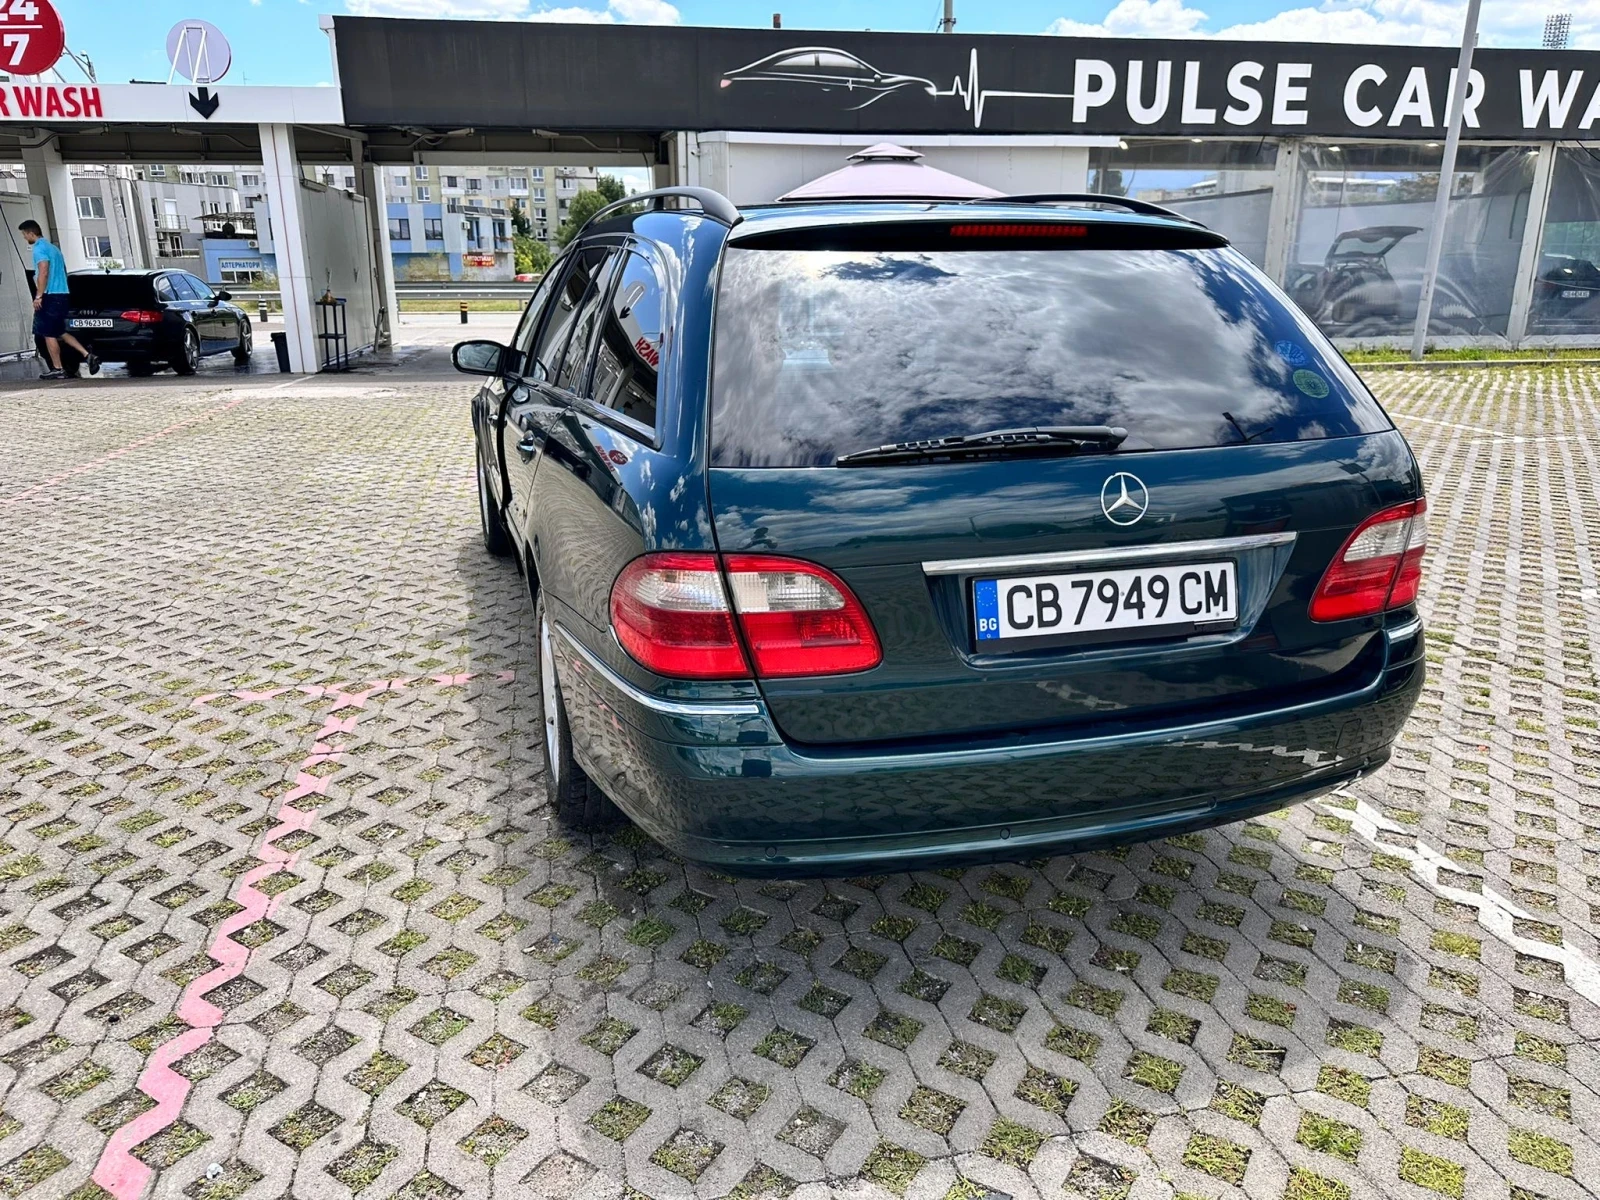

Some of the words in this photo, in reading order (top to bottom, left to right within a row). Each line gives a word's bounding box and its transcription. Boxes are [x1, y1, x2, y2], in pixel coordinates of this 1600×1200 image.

[3, 34, 30, 66] 7
[12, 86, 103, 118] WASH
[1072, 59, 1312, 125] PULSE
[1343, 63, 1486, 128] CAR
[1006, 582, 1063, 630] CB
[1071, 574, 1169, 625] 7949
[1179, 569, 1228, 615] CM
[979, 618, 997, 632] BG
